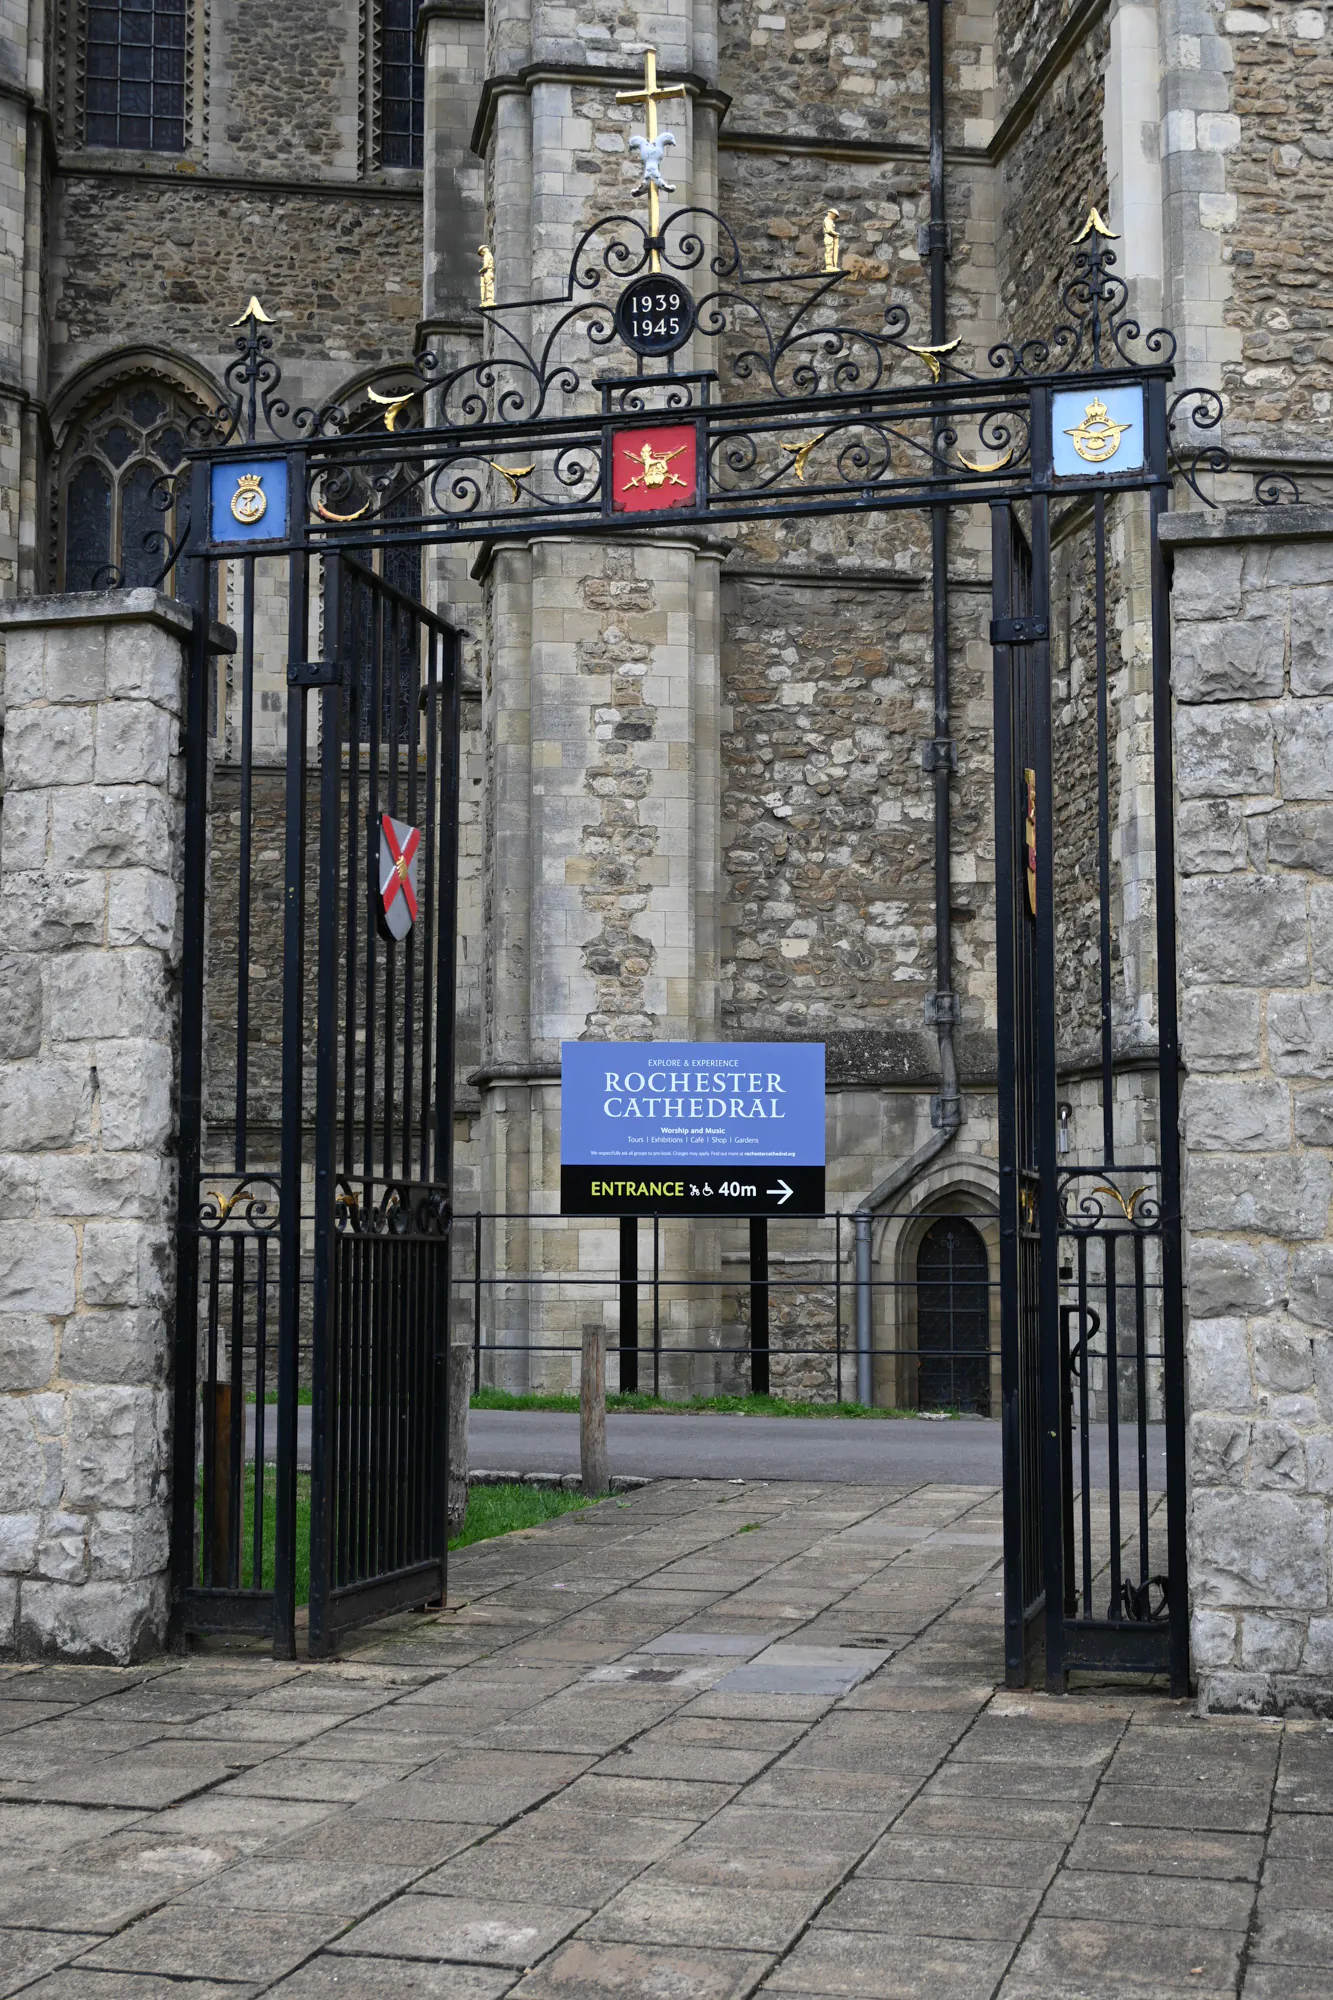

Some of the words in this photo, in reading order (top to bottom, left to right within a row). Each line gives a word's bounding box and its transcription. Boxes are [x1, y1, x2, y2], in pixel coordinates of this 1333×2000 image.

[632, 294, 680, 313] 1939
[633, 317, 680, 337] 1945
[648, 1059, 681, 1067] EXPLORE
[683, 1059, 690, 1067] &
[691, 1059, 739, 1067] EXPERIENCE
[603, 1072, 787, 1093] ROCHESTER
[603, 1097, 786, 1119] CATHEDRAL
[660, 1126, 689, 1135] Worship
[705, 1127, 726, 1135] Music
[711, 1136, 728, 1145] Shop
[591, 1181, 685, 1197] ENTRANCE
[718, 1181, 757, 1197] 40m
